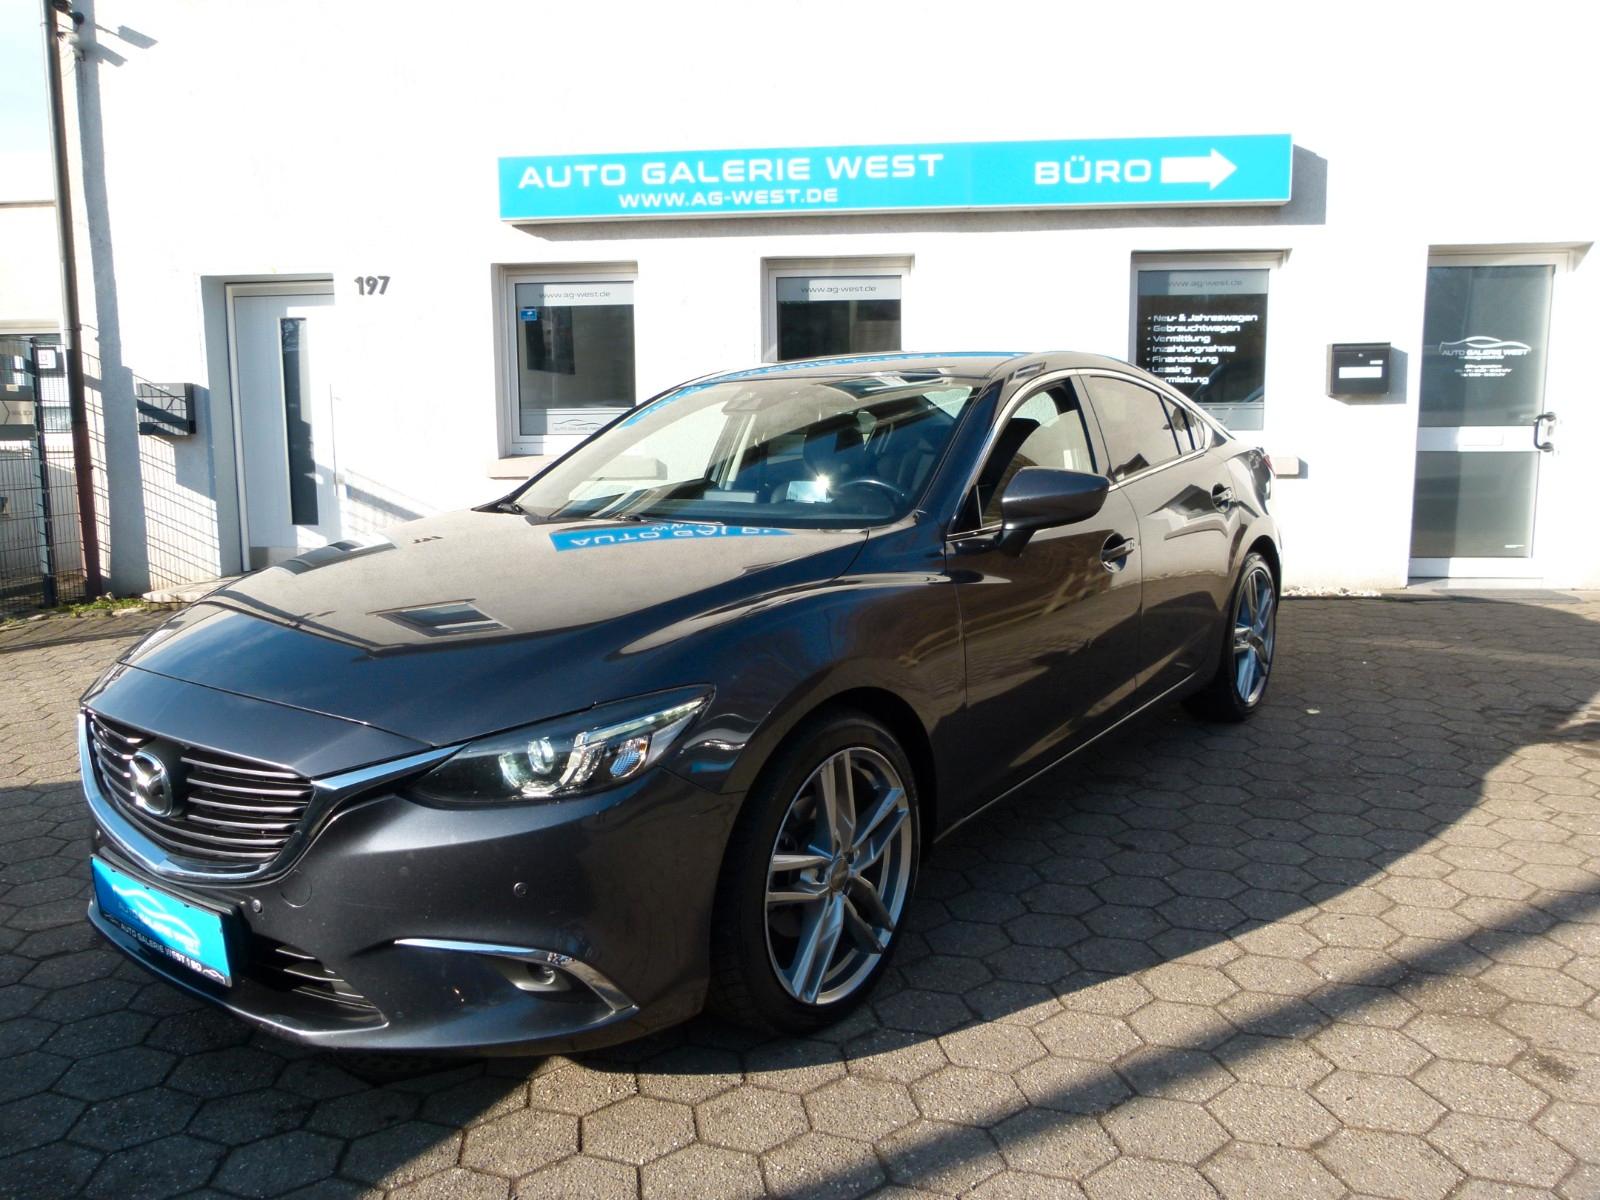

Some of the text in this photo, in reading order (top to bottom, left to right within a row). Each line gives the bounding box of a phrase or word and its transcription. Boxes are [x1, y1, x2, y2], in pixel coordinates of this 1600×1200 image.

[518, 153, 944, 190] AUTO GALERIE WEST
[1034, 155, 1152, 185] BÜRO
[618, 187, 839, 209] WWW.AG-WEST.DE
[354, 275, 391, 296] 197
[801, 285, 877, 294] www.ag-west.de
[539, 290, 611, 299] www.ag-west.de
[1187, 313, 1259, 323] Jahreswagen
[1152, 324, 1241, 333] Gebrauchtwagen
[1152, 334, 1211, 344] Vermittlung
[1152, 344, 1236, 354] Inzahlungnahme
[1152, 355, 1219, 365] Finanzierung
[1151, 366, 1192, 375] Leasing
[1160, 375, 1210, 385] rmietung
